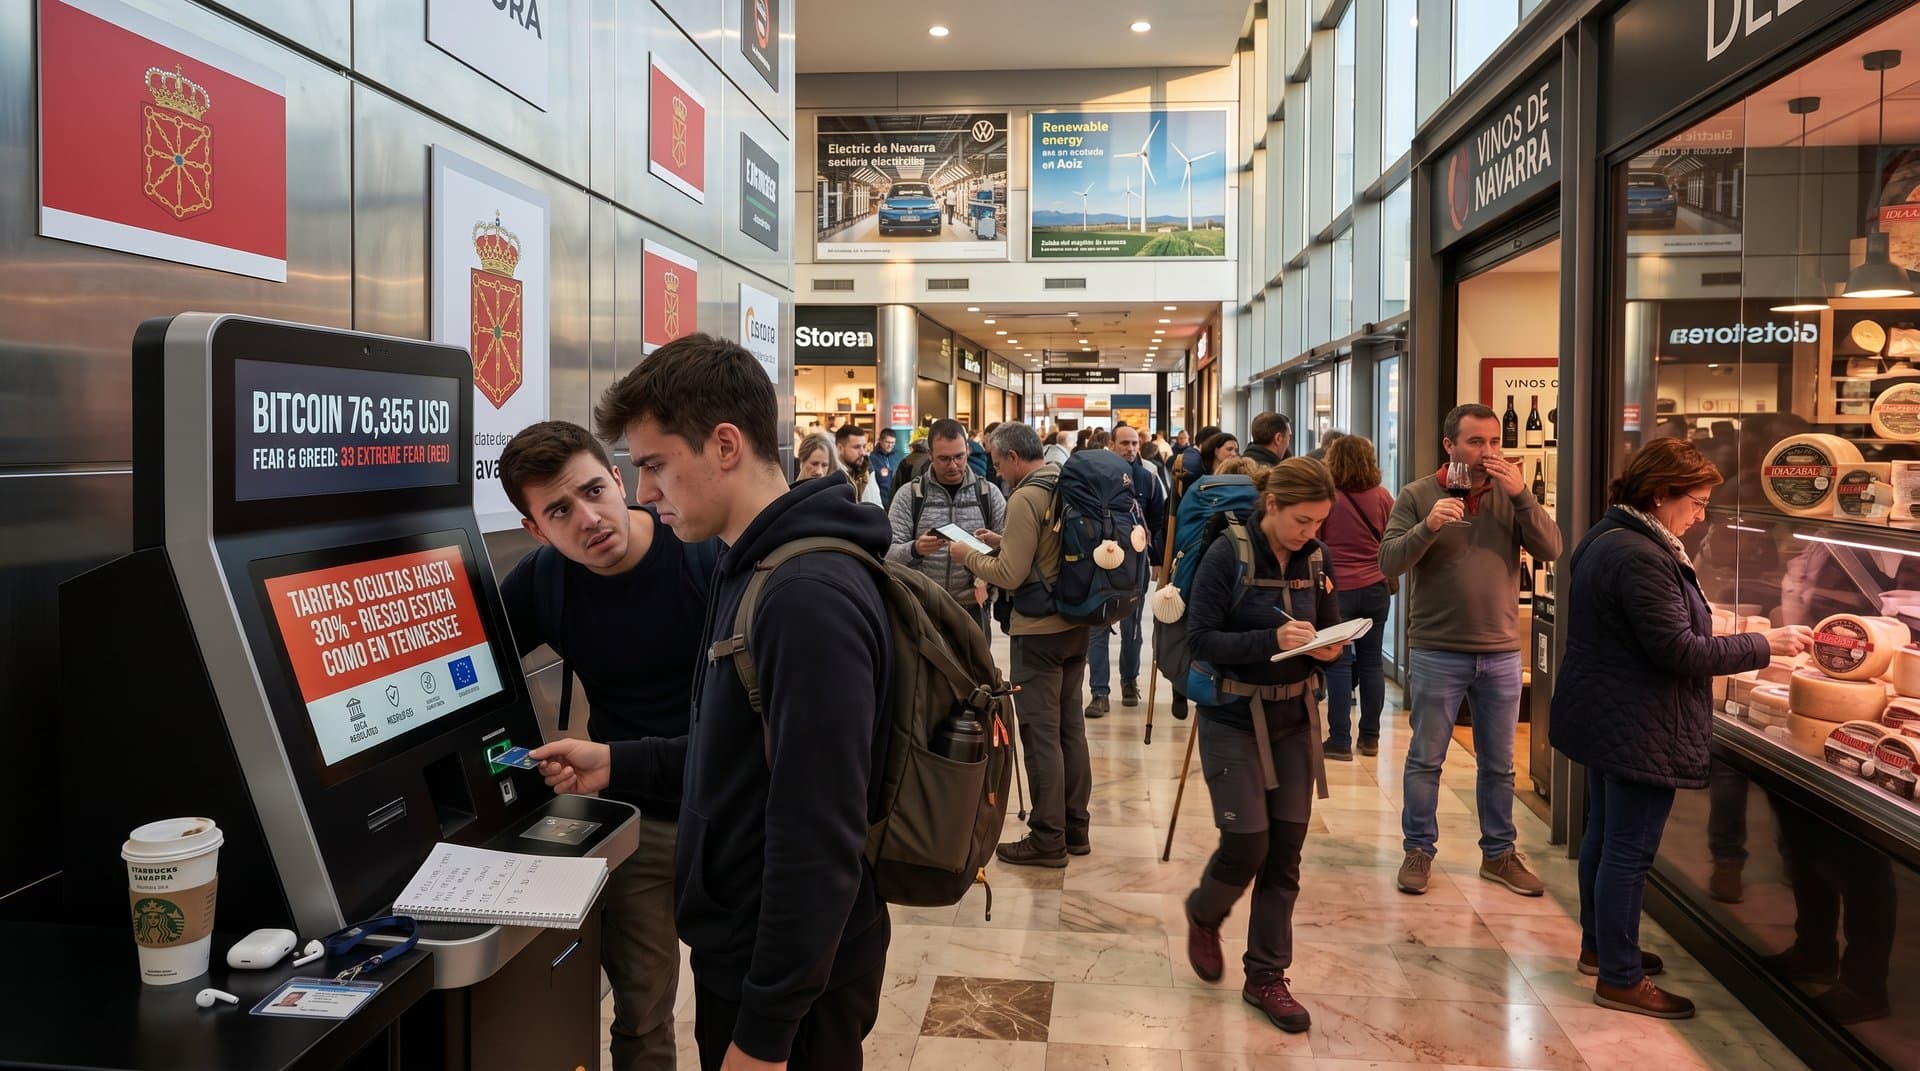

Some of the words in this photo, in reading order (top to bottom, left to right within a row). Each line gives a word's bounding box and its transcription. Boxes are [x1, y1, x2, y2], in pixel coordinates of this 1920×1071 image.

[1042, 122, 1108, 132] Renewable
[1042, 136, 1083, 146] energy
[1478, 104, 1522, 167] VINOS
[1528, 82, 1549, 133] DE
[828, 143, 870, 154] Electric
[873, 143, 887, 153] de
[890, 142, 936, 153] Navarra
[1057, 158, 1082, 168] Aoiz
[1475, 128, 1552, 212] NAVARRA
[1505, 380, 1546, 388] VINOS
[253, 390, 342, 434] BITCOIN
[348, 396, 414, 439] 76,355
[418, 400, 450, 434] USD
[253, 448, 285, 470] FEAR
[288, 448, 296, 469] &
[299, 447, 338, 468] GREED:
[341, 446, 354, 467] 33
[357, 446, 401, 466] EXTREME
[404, 444, 424, 464] FEAR
[427, 444, 450, 464] (RED)
[287, 580, 354, 618] TARIFAS
[353, 568, 414, 603] OCULTAS
[412, 560, 456, 588] HASTA
[311, 614, 350, 646] 30%
[358, 599, 409, 634] RIESGO
[411, 588, 457, 620] ESTAFA
[322, 641, 368, 677] COMO
[367, 636, 390, 663] EN
[388, 614, 462, 656] TENNESSEE
